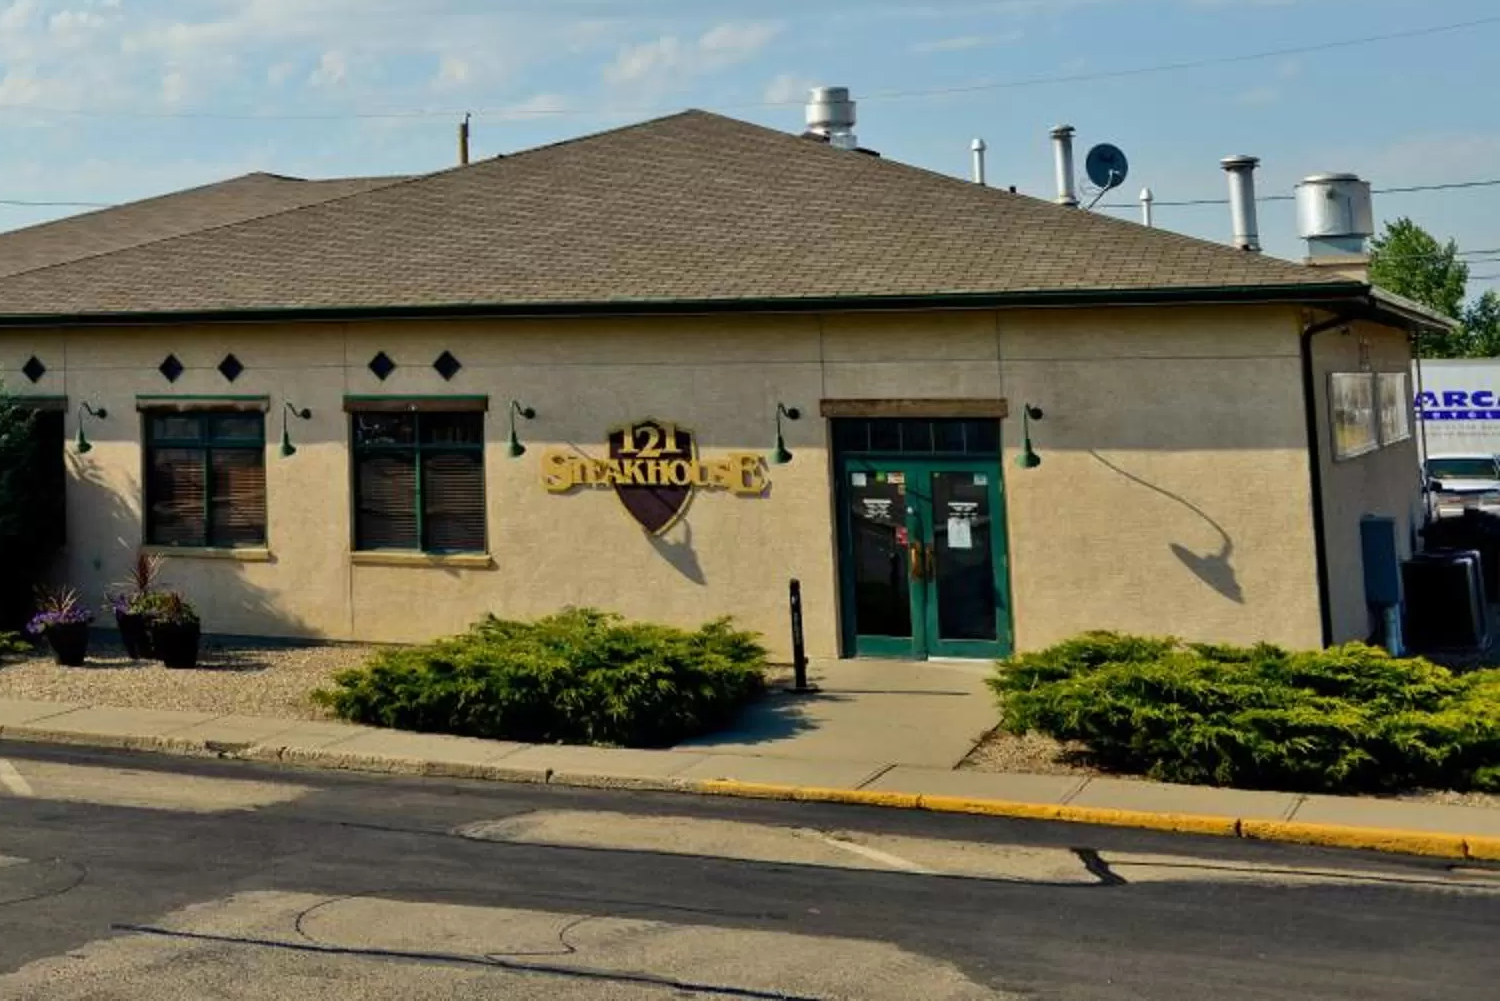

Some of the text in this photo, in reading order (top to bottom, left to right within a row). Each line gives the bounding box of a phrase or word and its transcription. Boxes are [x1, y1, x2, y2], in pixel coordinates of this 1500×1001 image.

[1414, 390, 1500, 407] ARC
[618, 423, 683, 458] 121
[542, 452, 771, 497] STEAKHOUSE
